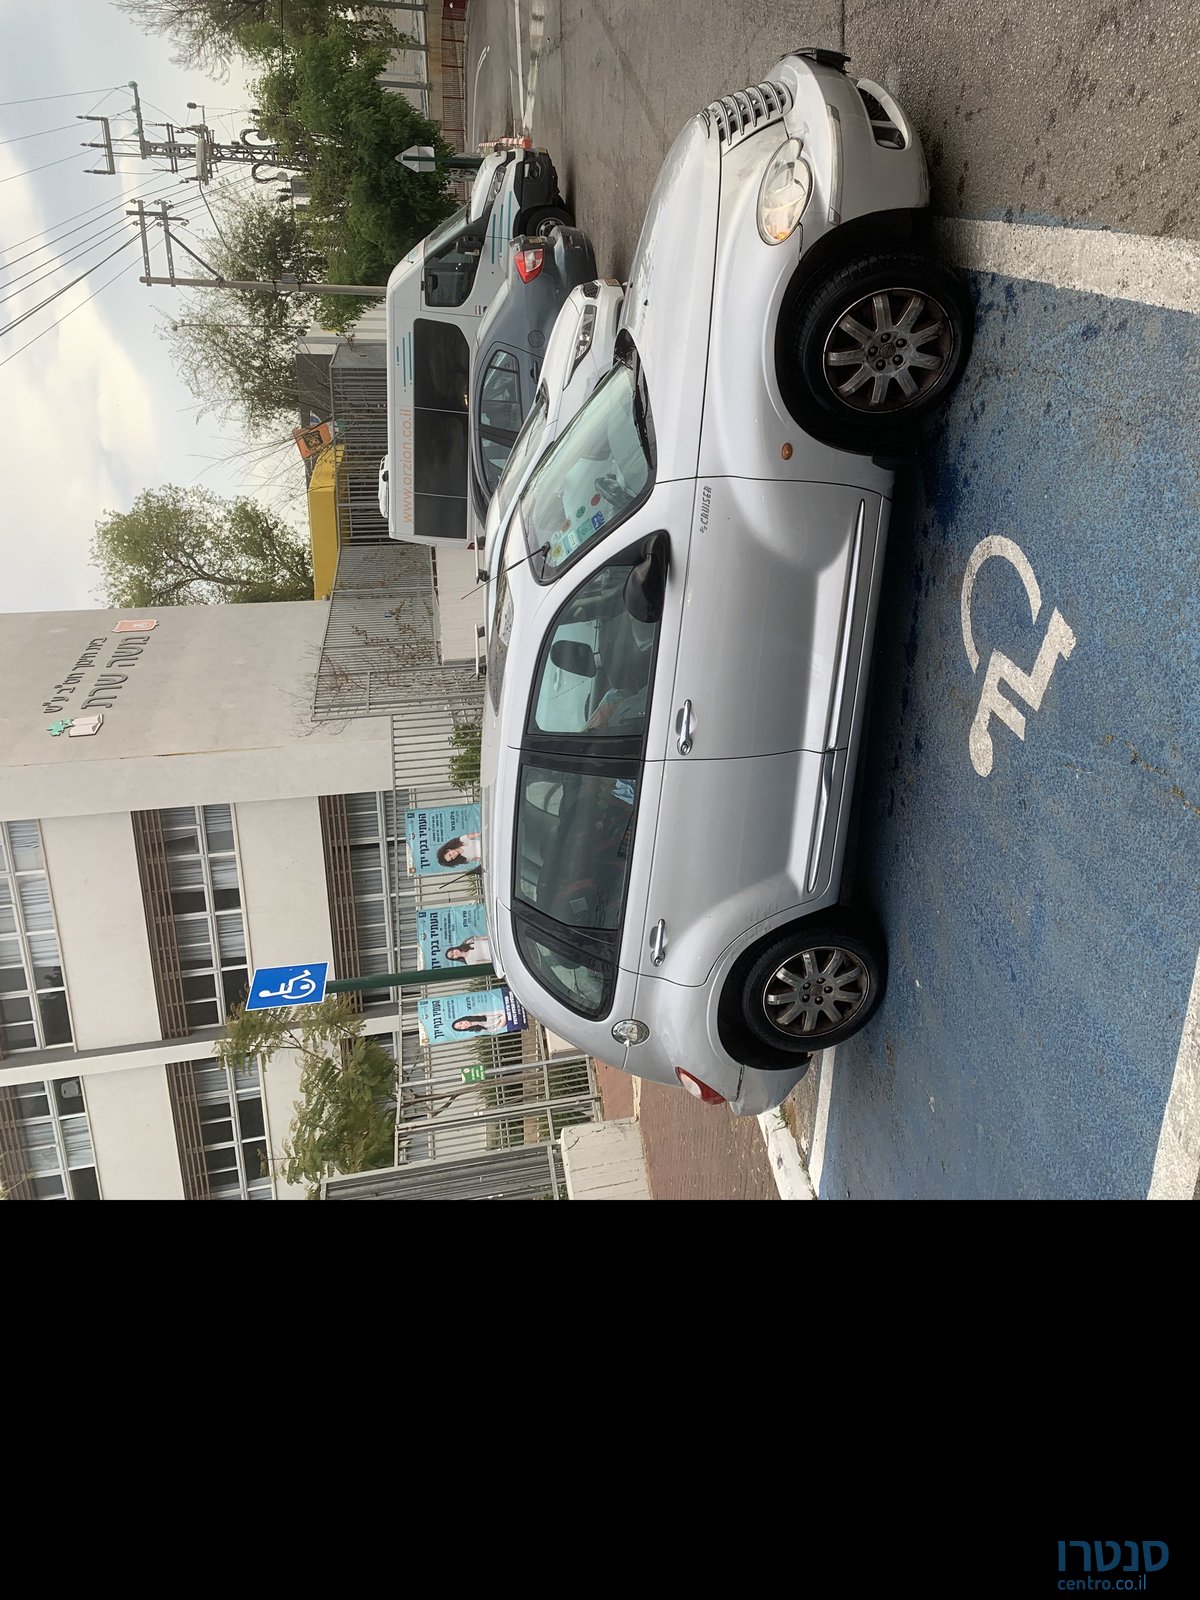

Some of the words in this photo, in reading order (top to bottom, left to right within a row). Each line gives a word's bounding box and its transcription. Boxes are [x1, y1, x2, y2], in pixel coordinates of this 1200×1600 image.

[400, 408, 412, 523] www.orzion.co.il
[700, 486, 712, 525] CRUISER
[86, 637, 107, 650] בית
[106, 636, 149, 668] משה
[80, 673, 128, 709] שרת
[418, 813, 427, 838] העתיד
[420, 840, 429, 854] בכף
[420, 857, 430, 869] ידך
[430, 912, 439, 938] העתיד
[431, 940, 440, 955] בכף
[432, 1000, 441, 1016] העתיד
[434, 1017, 444, 1028] בכף
[434, 1029, 445, 1039] ידך
